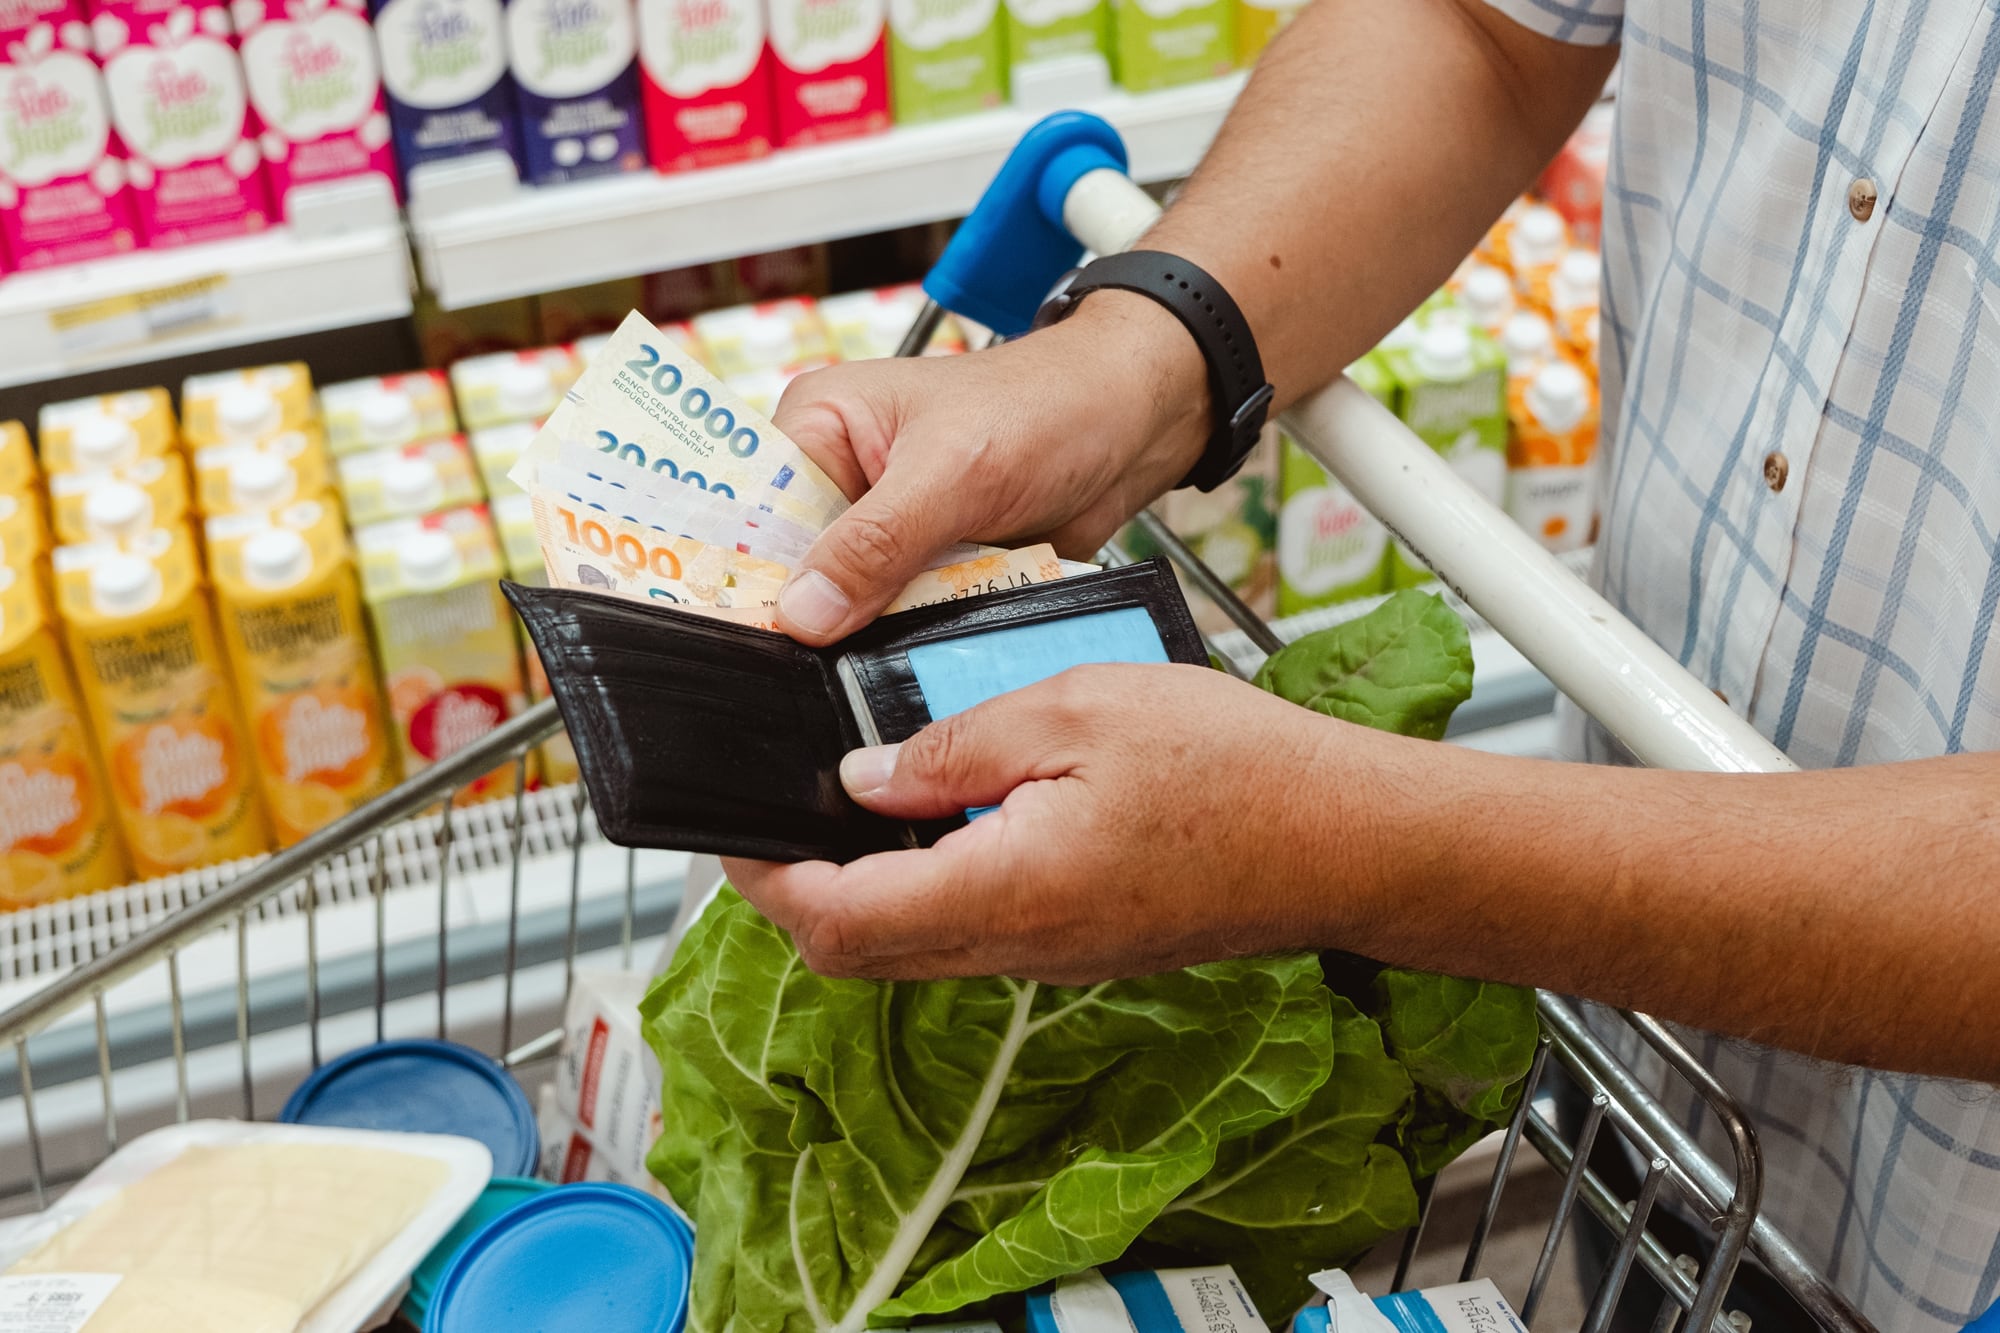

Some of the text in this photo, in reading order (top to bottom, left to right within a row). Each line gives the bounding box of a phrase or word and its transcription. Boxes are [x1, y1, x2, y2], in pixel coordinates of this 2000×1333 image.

[612, 378, 661, 421] REPÚBLICA
[618, 370, 716, 454] BANCO CENTRAL DE LA
[557, 506, 683, 581] 1000
